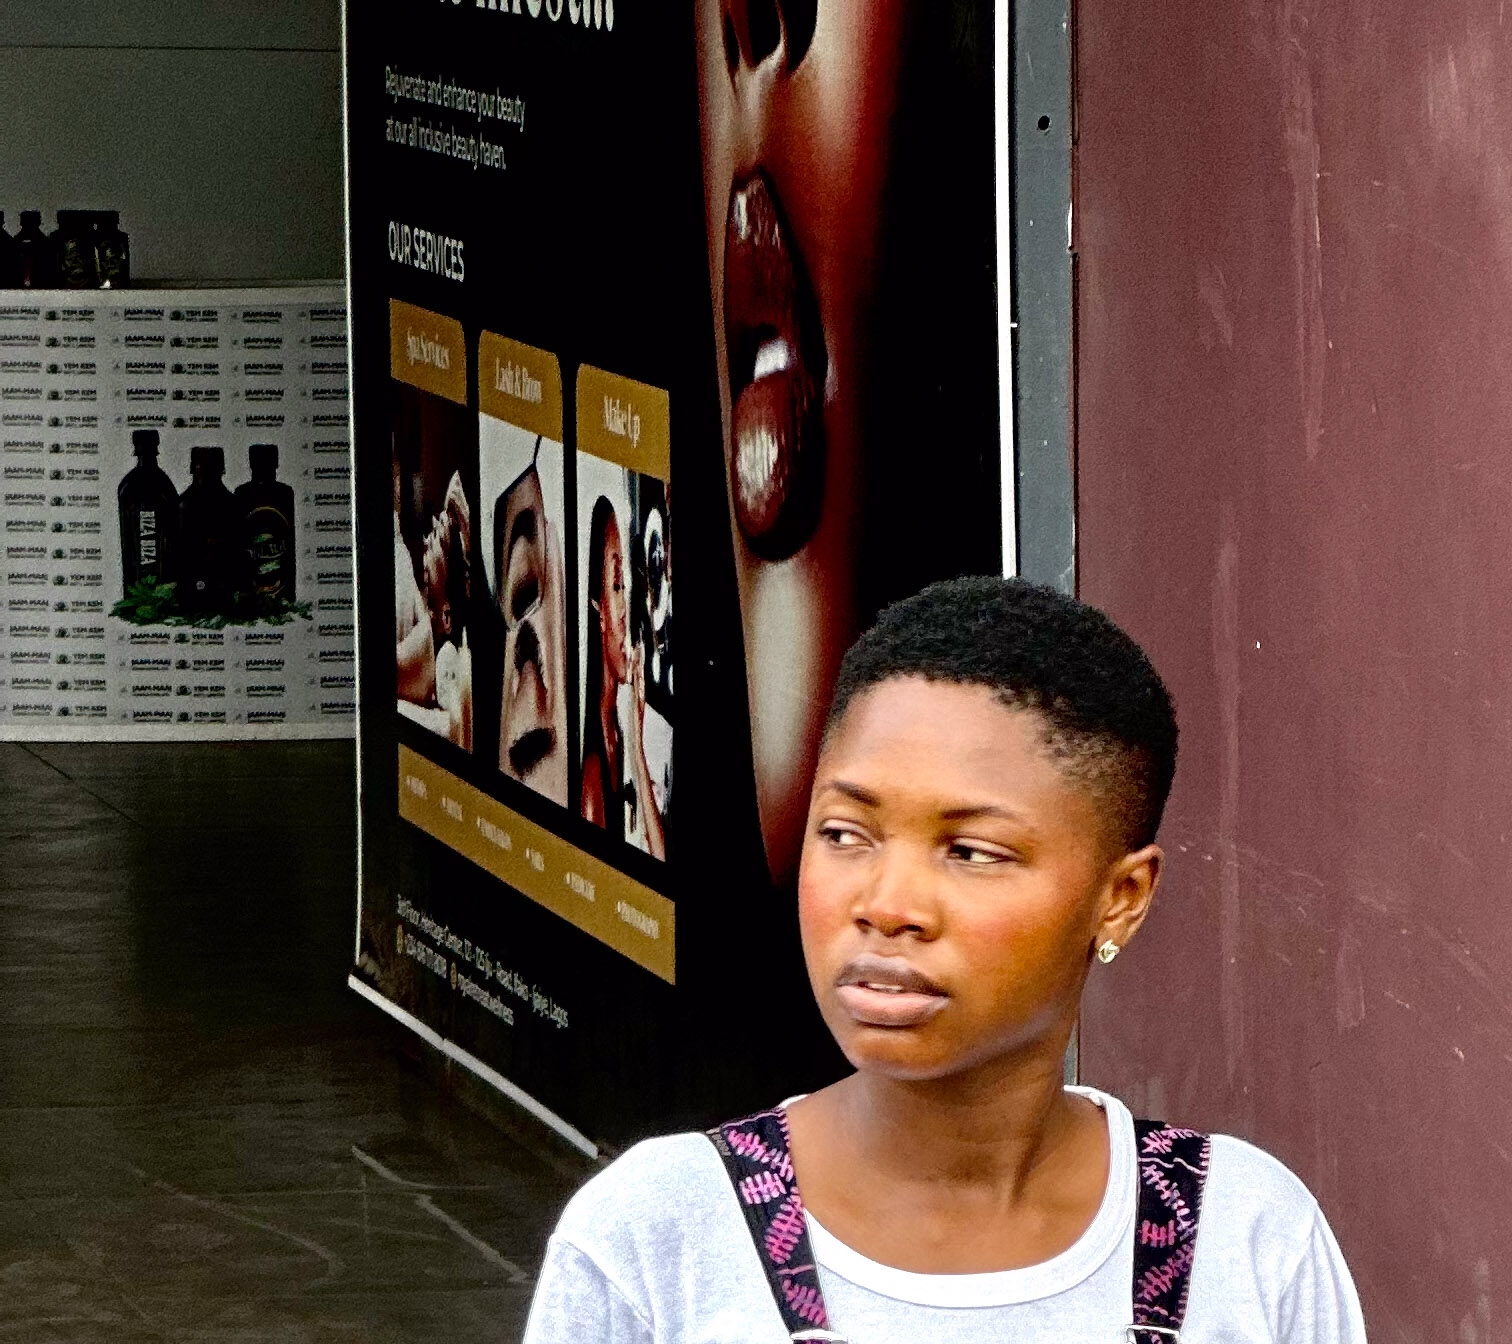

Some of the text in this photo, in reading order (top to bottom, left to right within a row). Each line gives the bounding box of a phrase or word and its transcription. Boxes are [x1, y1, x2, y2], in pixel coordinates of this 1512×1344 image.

[428, 75, 441, 105] and
[444, 78, 475, 113] enhance
[477, 92, 494, 122] your
[497, 87, 525, 132] beauty
[395, 121, 407, 144] our
[452, 125, 480, 170] beauty
[389, 220, 464, 282] OUR SERVICES
[604, 394, 641, 448] Make Up
